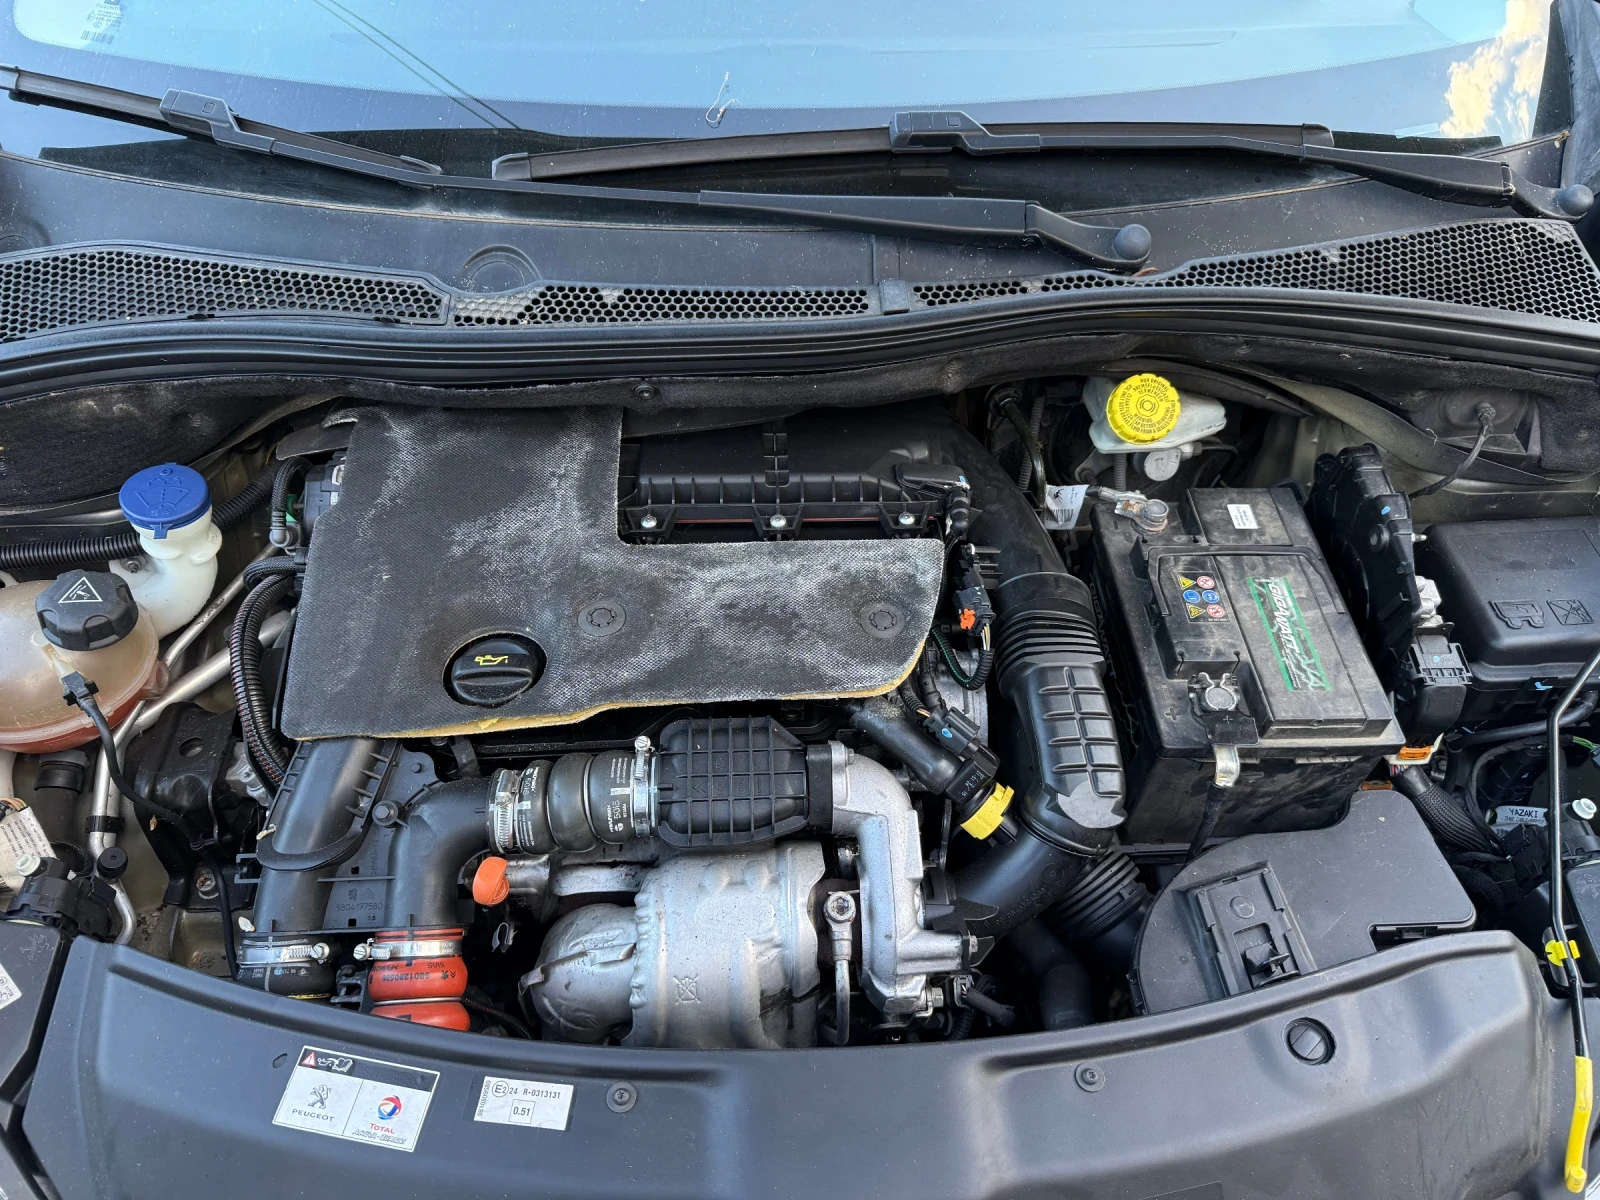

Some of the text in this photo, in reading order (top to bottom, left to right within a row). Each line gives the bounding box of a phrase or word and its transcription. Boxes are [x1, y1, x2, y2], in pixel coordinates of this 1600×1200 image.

[1268, 583, 1299, 653] GIGAWATT
[1509, 808, 1538, 818] YAZAKI
[336, 903, 384, 911] 9804177580
[523, 1089, 561, 1099] R-0313131
[292, 1108, 334, 1122] PEUGEOT
[513, 1106, 531, 1117] 0.51
[370, 1122, 395, 1134] TOTAL
